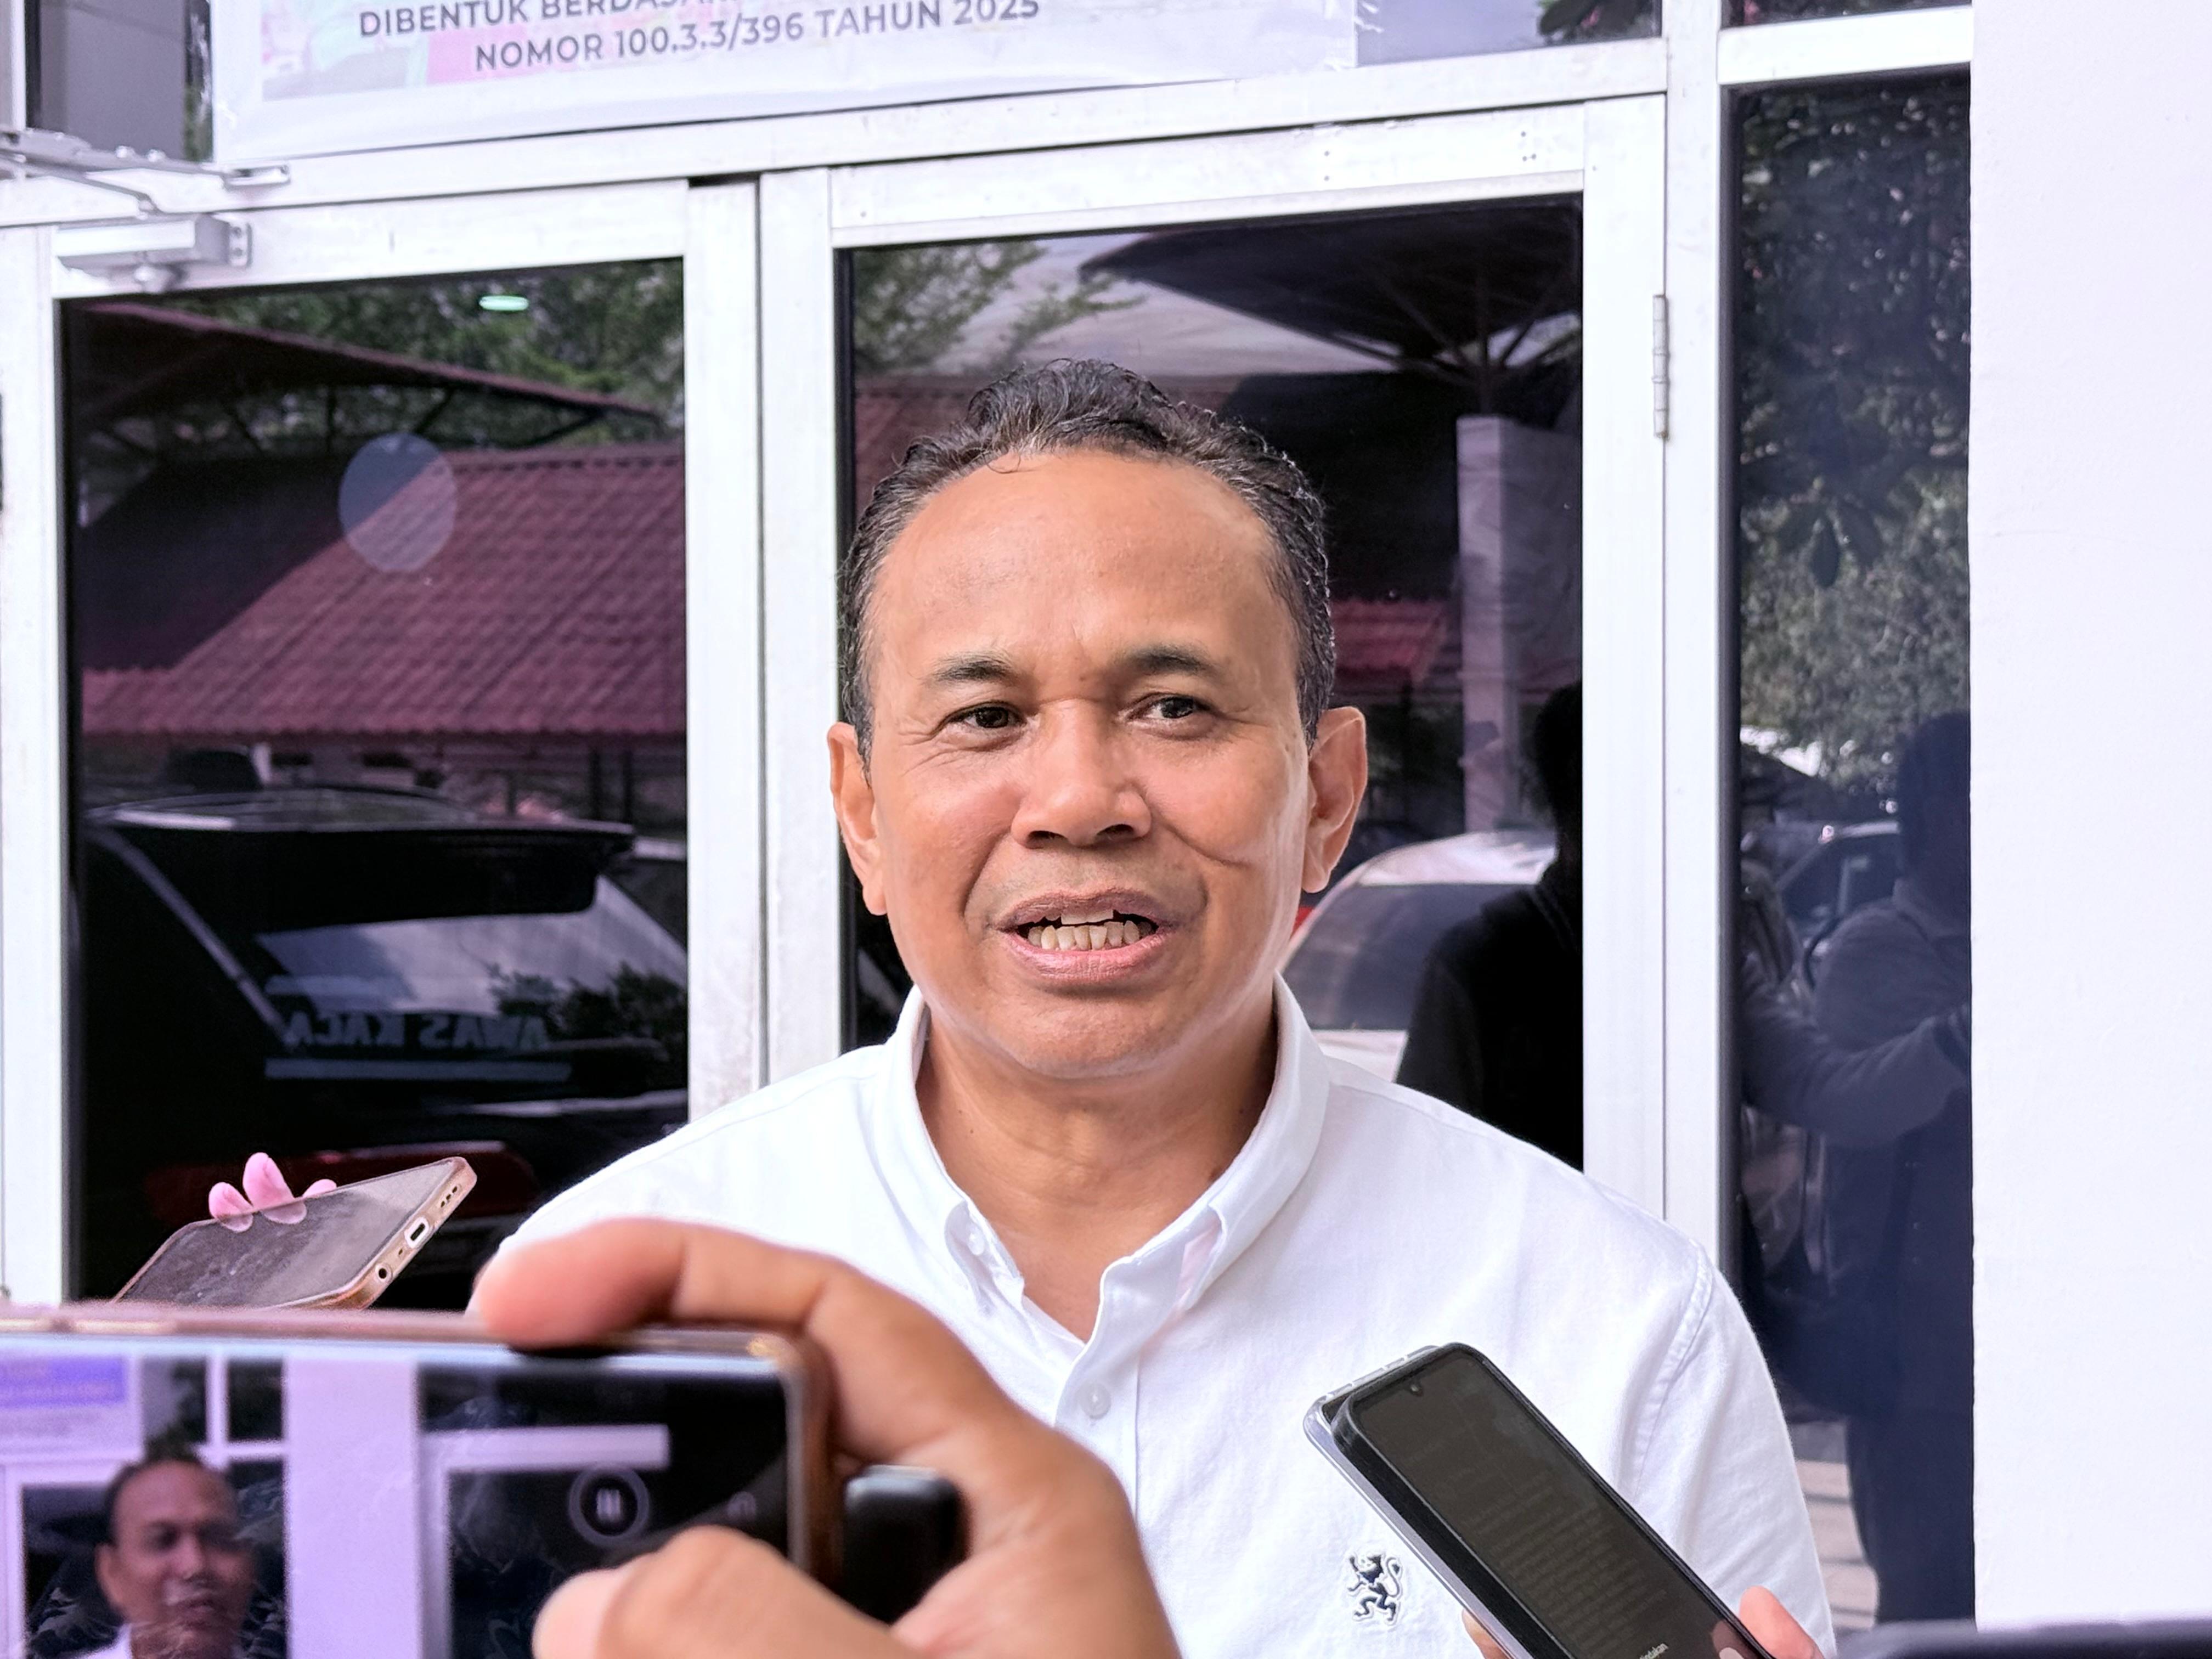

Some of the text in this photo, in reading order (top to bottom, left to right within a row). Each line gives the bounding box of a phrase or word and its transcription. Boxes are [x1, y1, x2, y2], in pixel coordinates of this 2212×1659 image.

[360, 0, 528, 37] DIBENTUK
[476, 0, 1039, 71] NOMOR 100.3.3/396 TAHUN 2025
